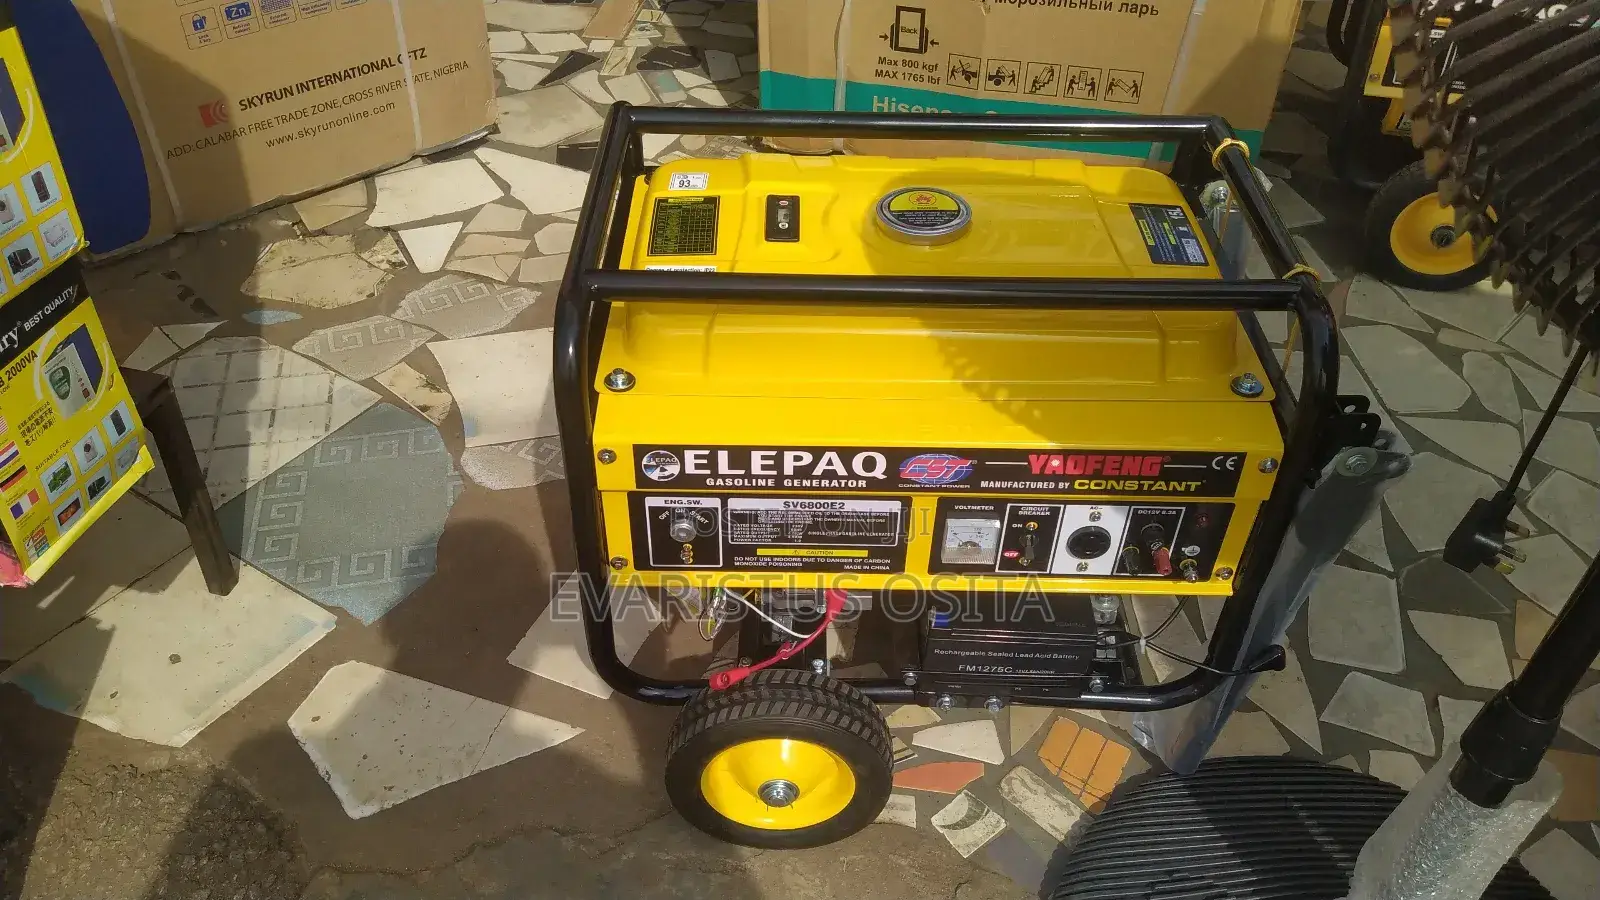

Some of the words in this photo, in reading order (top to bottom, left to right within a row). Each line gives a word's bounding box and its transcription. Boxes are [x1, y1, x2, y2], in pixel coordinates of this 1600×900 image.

[230, 7, 247, 18] Zn
[1117, 3, 1159, 18] ларь
[900, 25, 918, 34] Back
[878, 56, 899, 67] Max
[901, 59, 919, 69] 800
[922, 61, 939, 73] kgf
[238, 85, 295, 112] SKYRUN
[295, 56, 396, 95] INTERNATIONAL
[875, 69, 899, 80] MAX
[901, 72, 925, 83] 1765
[927, 75, 941, 85] lbf
[166, 143, 195, 160] ADD:
[195, 127, 248, 150] CALABAR
[248, 118, 274, 134] FREE
[274, 107, 310, 126] TRADE
[342, 88, 374, 106] CROSS
[375, 79, 403, 96] RIVER
[433, 60, 469, 79] NIGERIA
[265, 101, 396, 148] www.skyrunonline.com
[678, 179, 691, 188] 93
[23, 310, 46, 332] BEST
[44, 285, 74, 316] QUALITY
[5, 349, 39, 382] 2000VA
[34, 448, 60, 472] SUITABLE
[684, 450, 888, 479] ELEPAQ
[1028, 454, 1164, 477] YAOFENG
[705, 478, 776, 487] GASOLINE
[783, 478, 868, 488] GENERATOR
[980, 480, 1055, 489] MANUFACTURED
[1058, 481, 1070, 490] BY
[1073, 479, 1202, 492] CONSTANT
[783, 501, 846, 510] SV6800E2
[658, 510, 670, 520] OFF
[689, 510, 709, 524] START
[934, 648, 986, 657] Rechargeable
[958, 664, 1013, 673] FM1275C
